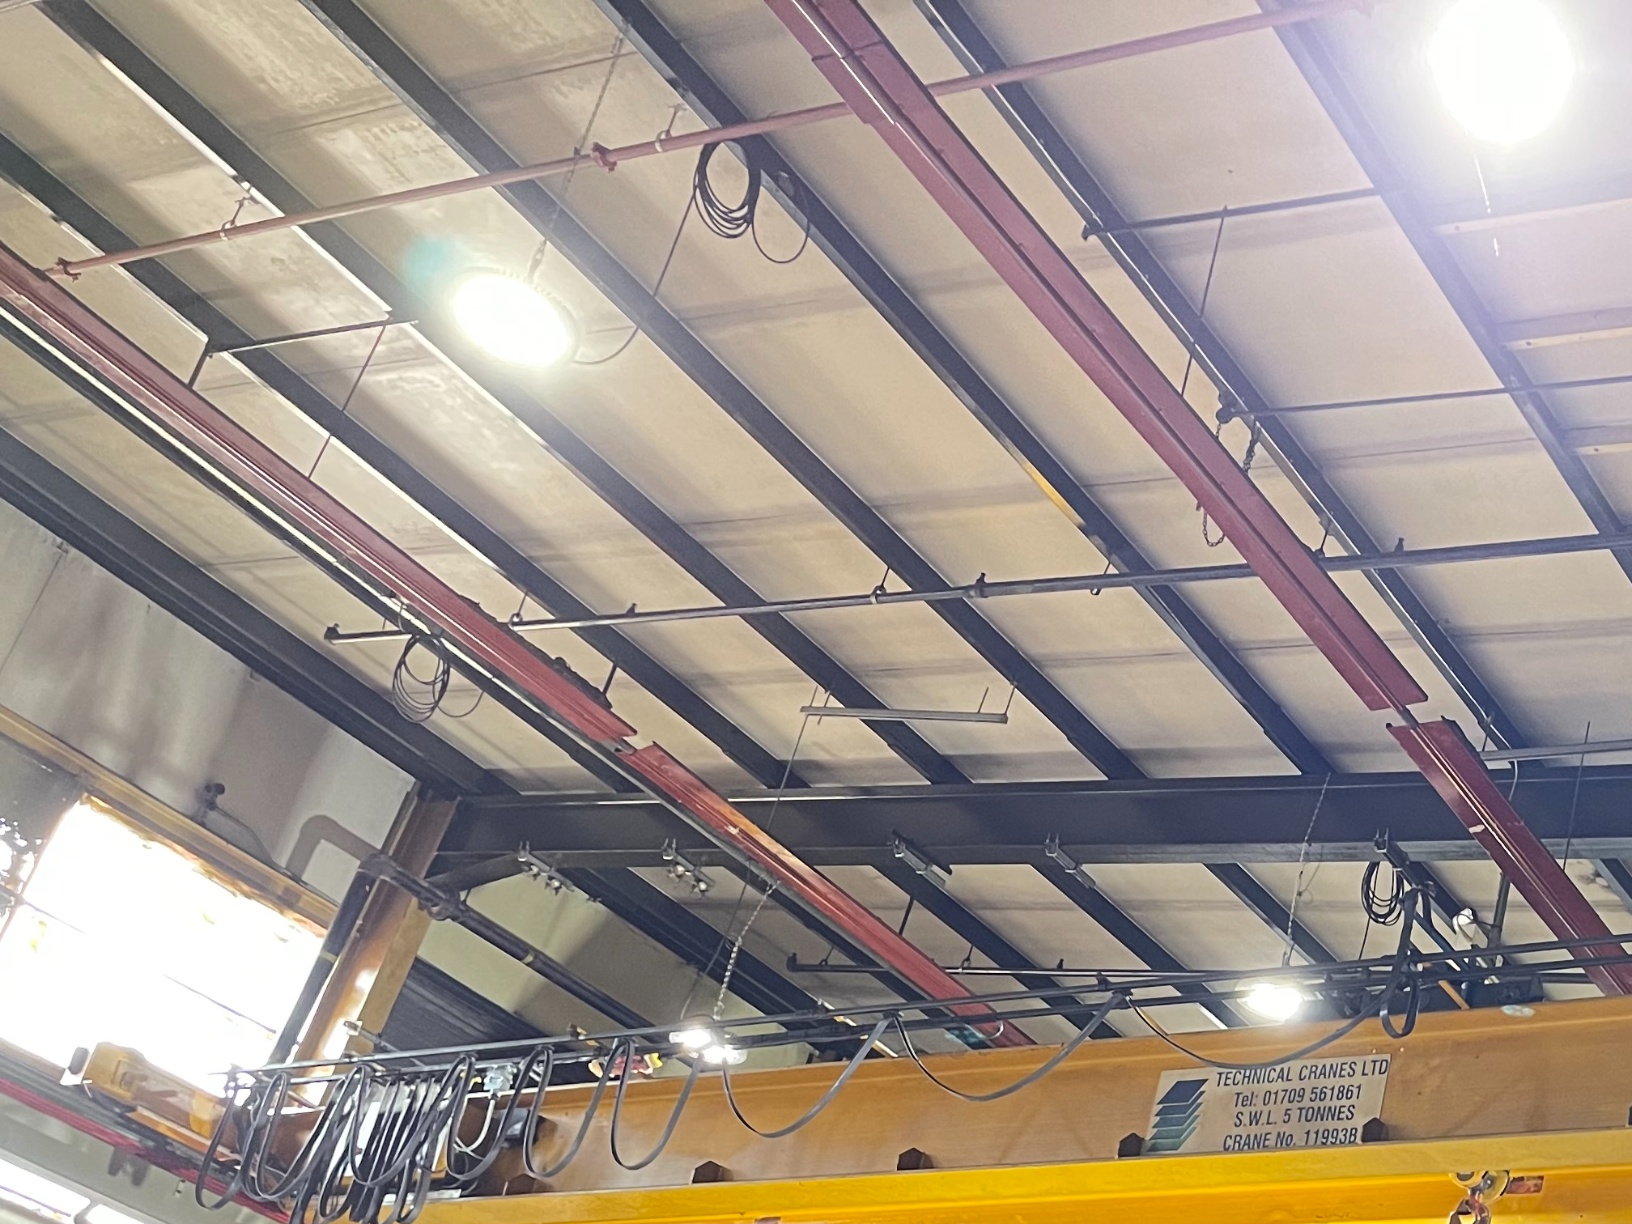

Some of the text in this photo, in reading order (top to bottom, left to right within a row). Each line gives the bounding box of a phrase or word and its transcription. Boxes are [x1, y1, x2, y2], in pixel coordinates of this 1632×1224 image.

[1216, 1059, 1388, 1088] TECHNICAL CRANES LTD
[1234, 1084, 1362, 1107] Tel: 01709 561861
[1234, 1105, 1355, 1128] S.W.L. 5 TONNES
[1223, 1127, 1358, 1152] CRANE No. 11993B
